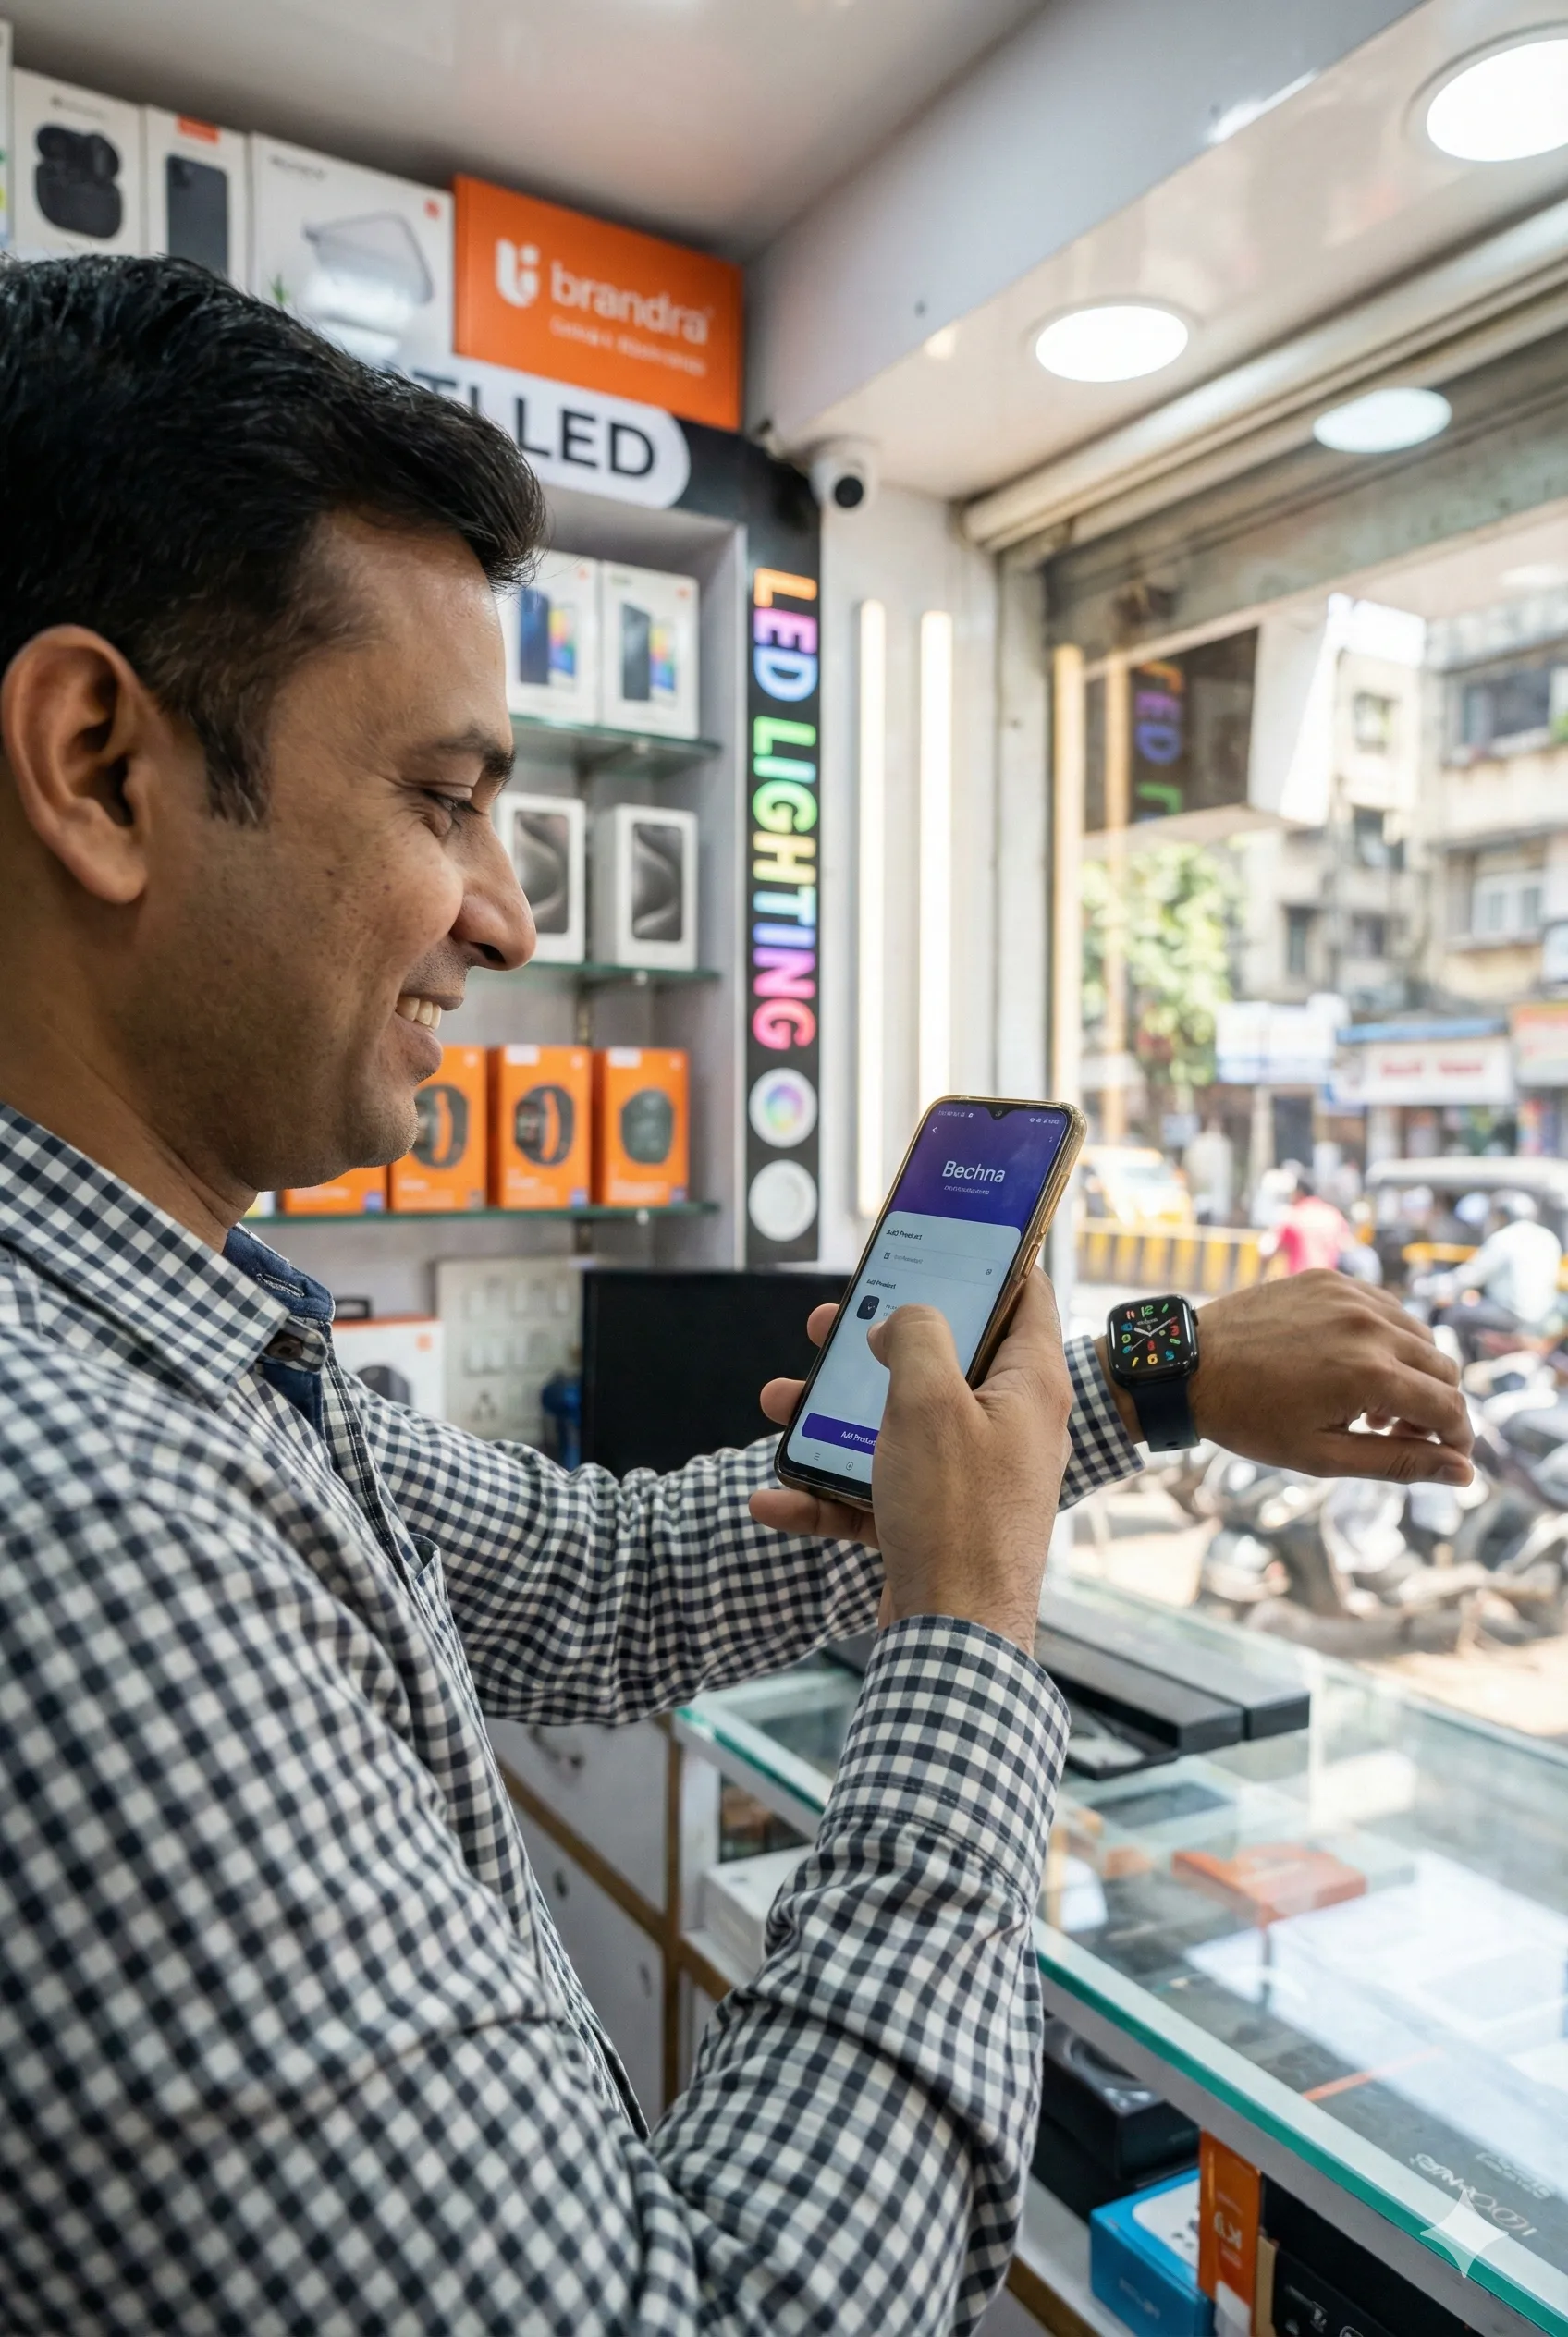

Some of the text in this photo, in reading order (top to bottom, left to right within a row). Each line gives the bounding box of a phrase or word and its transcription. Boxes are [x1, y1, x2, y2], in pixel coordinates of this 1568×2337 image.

[550, 260, 709, 345] brandra
[515, 396, 655, 478] LED
[753, 567, 818, 1051] LED LIGHTING
[941, 1160, 1006, 1183] Bechna
